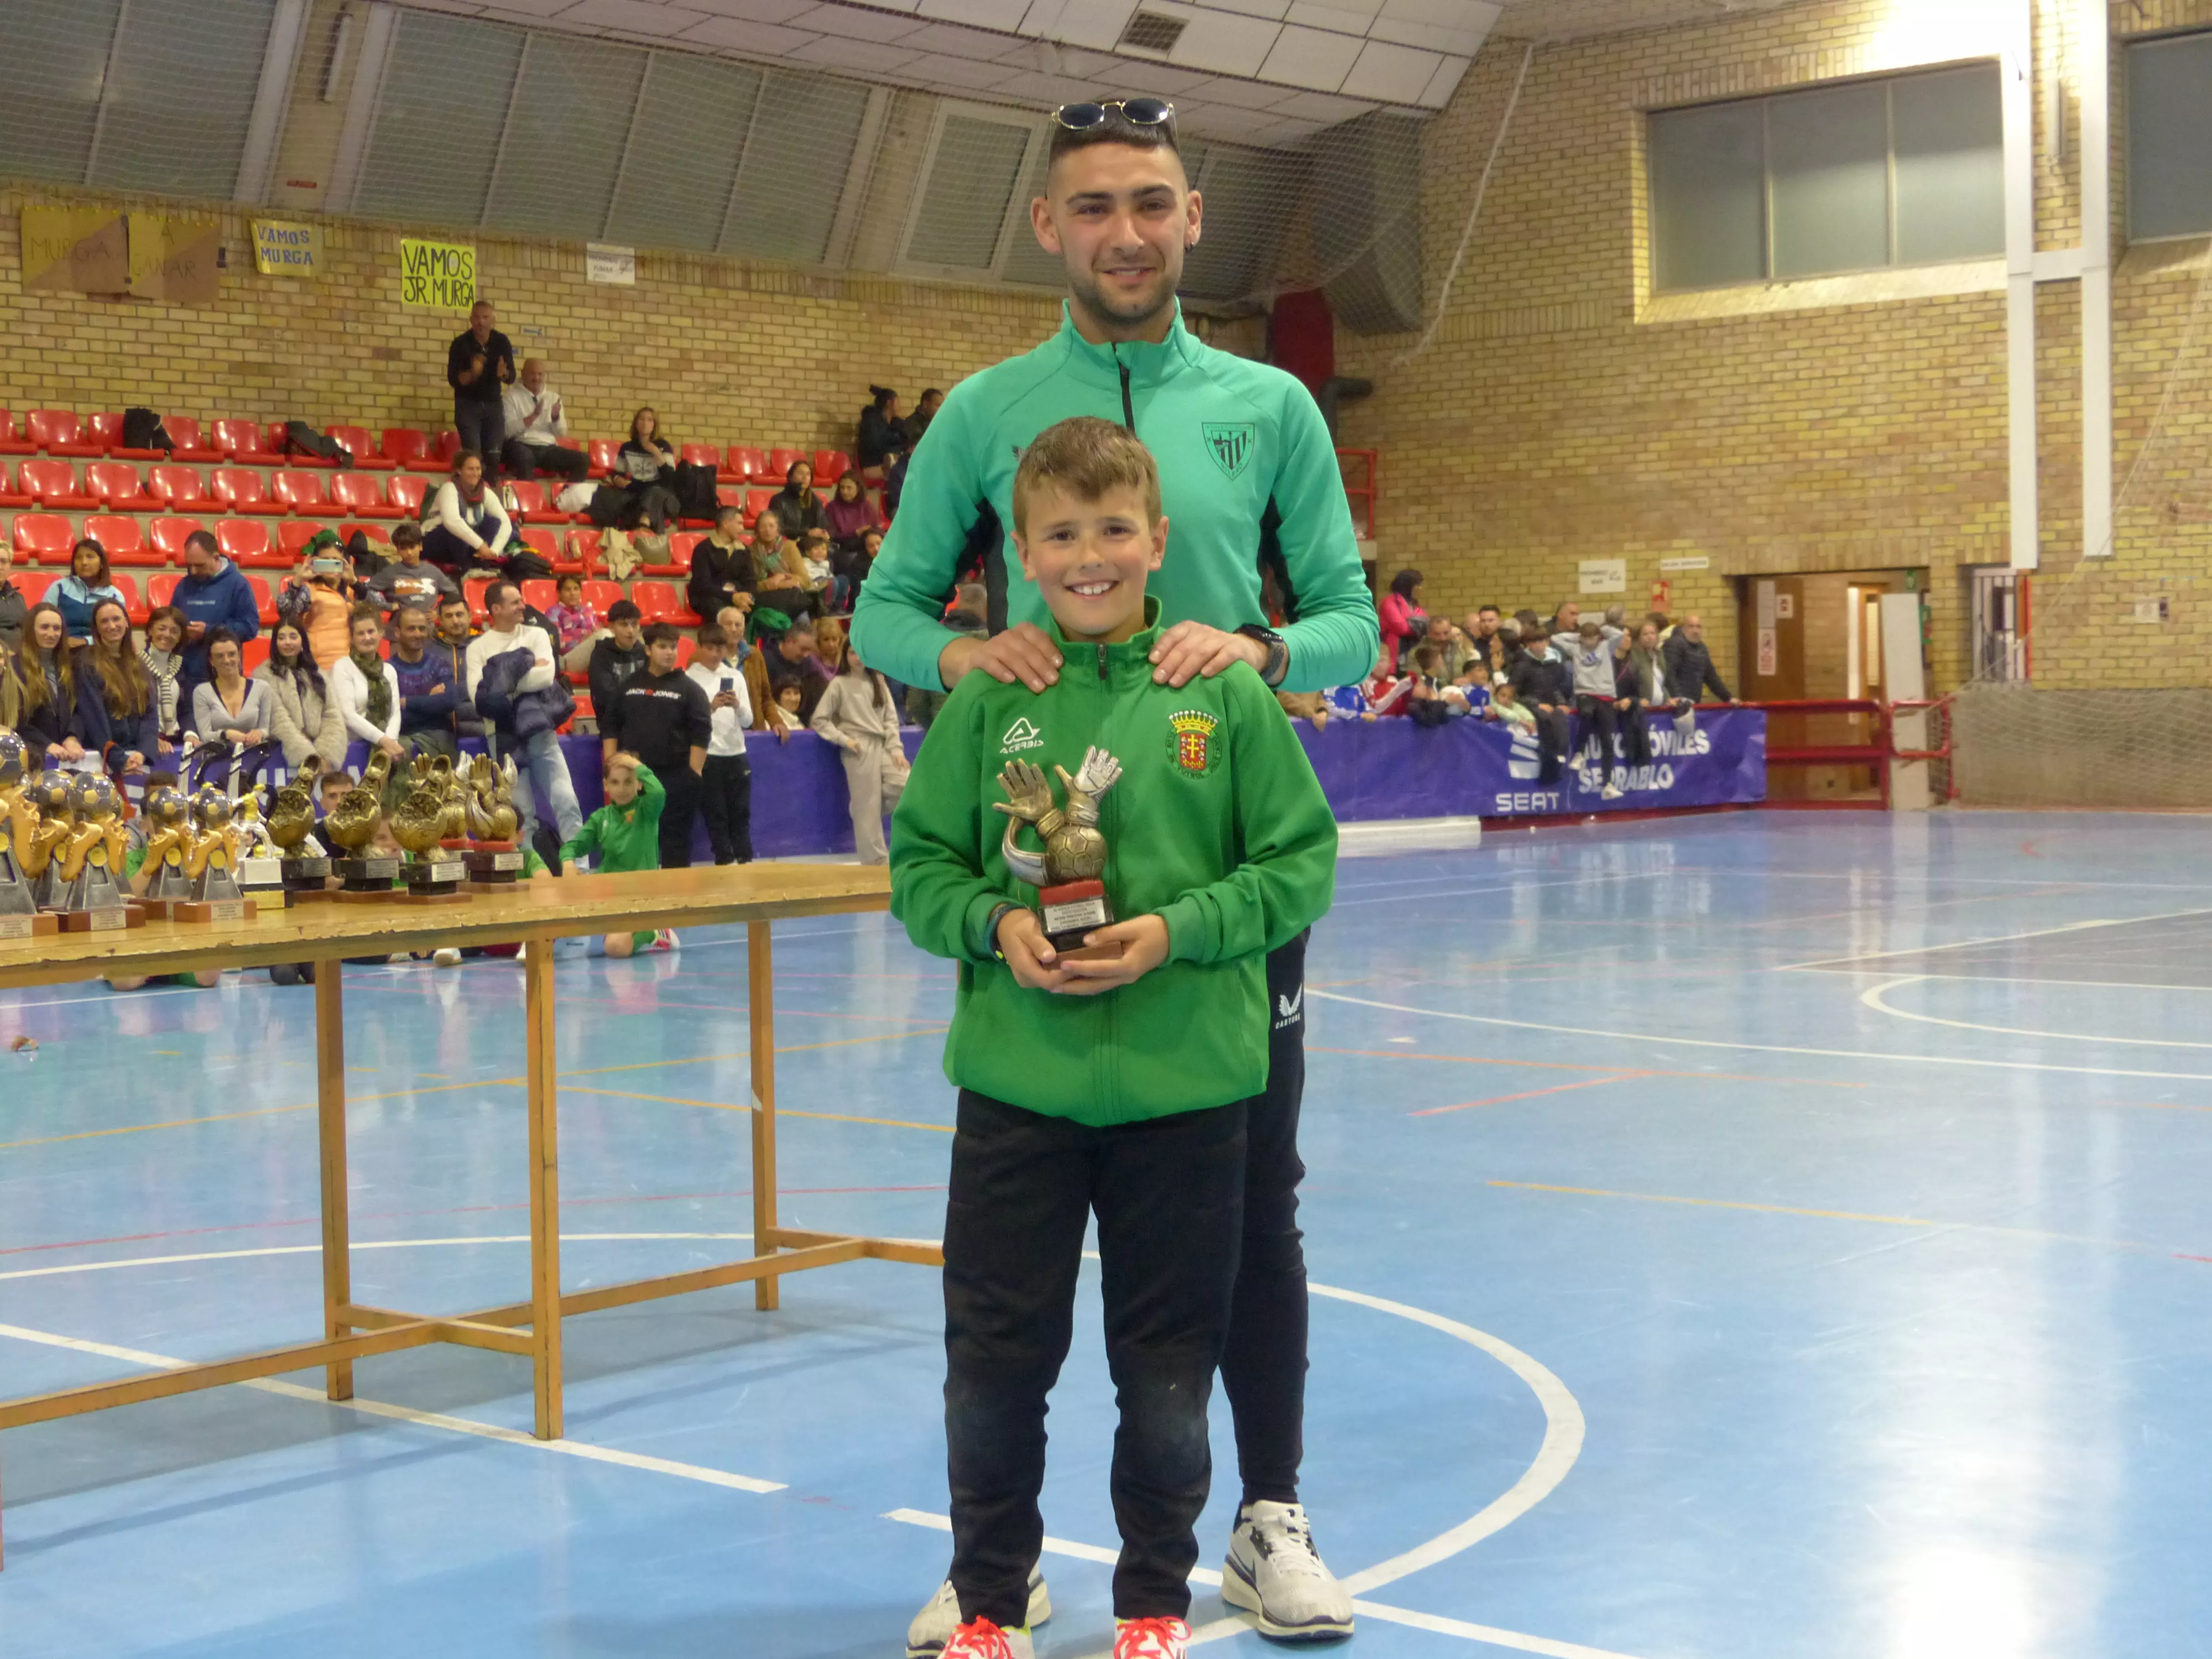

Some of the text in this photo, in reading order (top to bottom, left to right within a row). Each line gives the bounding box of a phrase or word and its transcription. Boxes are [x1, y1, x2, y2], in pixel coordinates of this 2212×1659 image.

[258, 226, 310, 246] VAMOS
[30, 237, 111, 262] MURGA
[260, 247, 314, 265] MURGA
[131, 254, 196, 281] GANAR
[403, 244, 473, 280] VAMOS
[404, 276, 474, 307] JR. MURGA
[625, 688, 646, 696] JACK
[999, 739, 1044, 753] ACERBIS
[1578, 763, 1673, 794] SERABLO
[1495, 792, 1560, 812] SEAT
